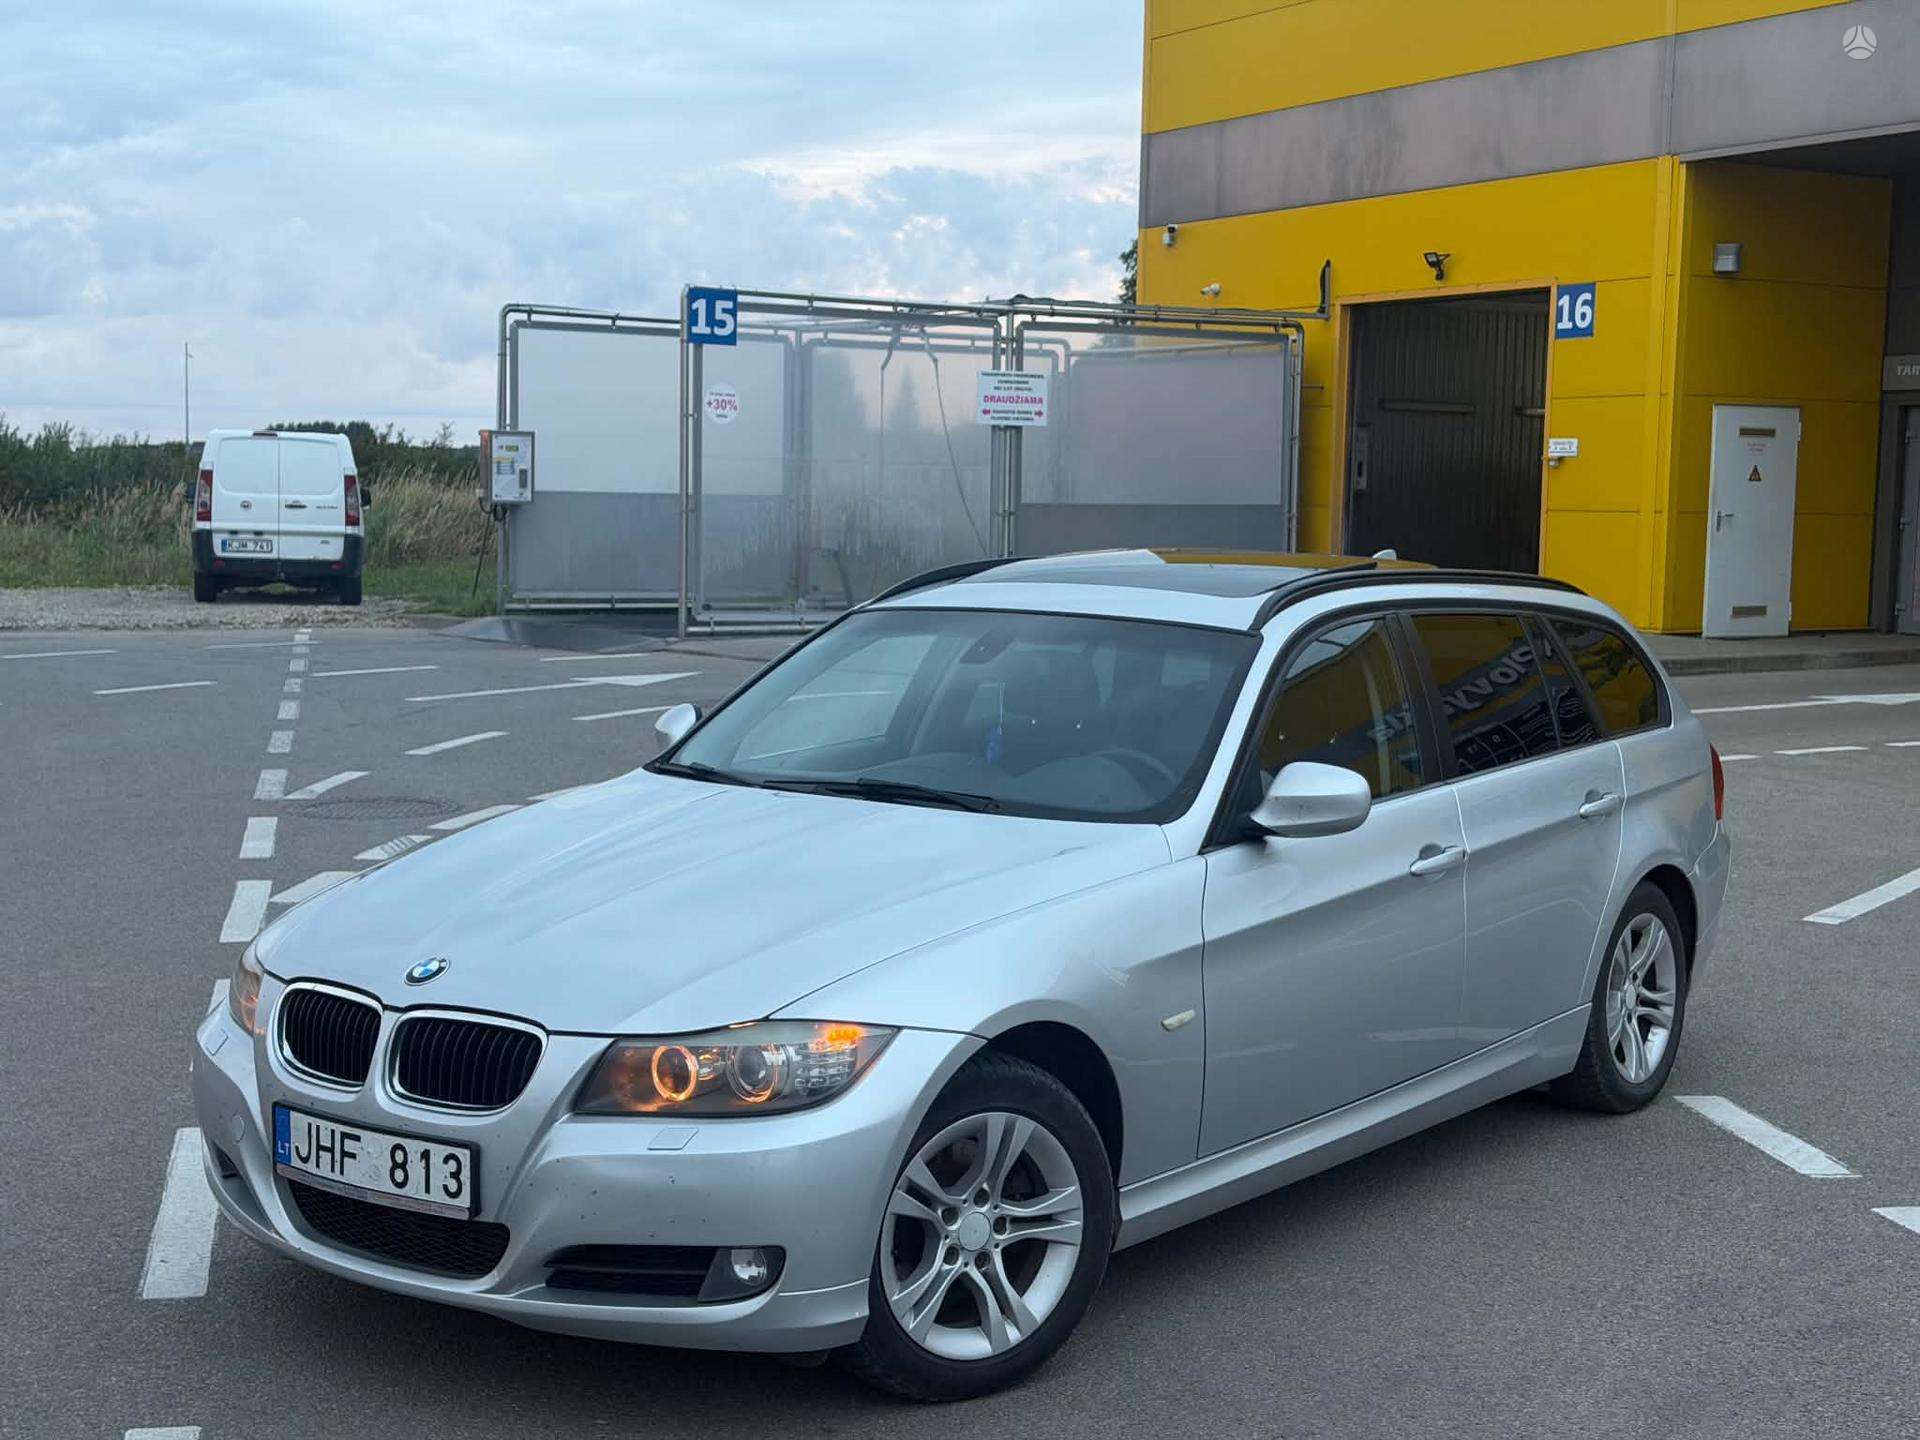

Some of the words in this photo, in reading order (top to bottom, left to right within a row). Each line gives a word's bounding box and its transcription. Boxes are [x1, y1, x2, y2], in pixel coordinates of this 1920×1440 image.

[691, 298, 735, 336] 15
[1556, 292, 1593, 330] 16
[706, 398, 738, 411] +30%
[278, 1141, 289, 1156] LT
[295, 1122, 361, 1176] JHF
[389, 1142, 463, 1199] 813
